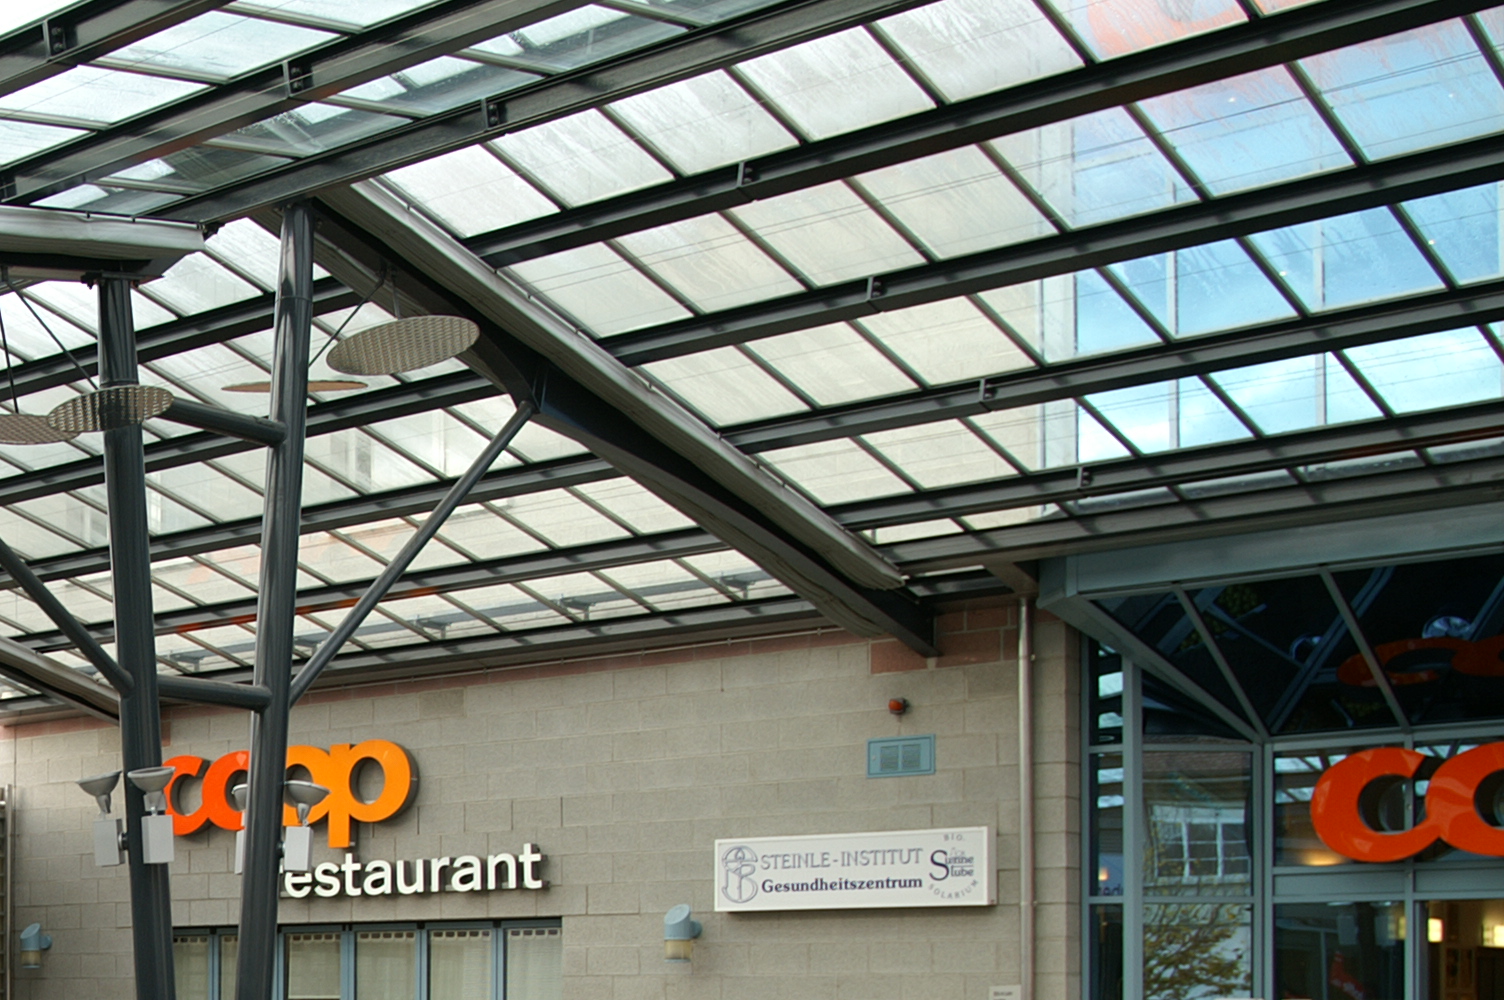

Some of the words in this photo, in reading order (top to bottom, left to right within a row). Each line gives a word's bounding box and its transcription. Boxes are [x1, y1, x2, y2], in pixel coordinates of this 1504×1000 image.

[163, 738, 413, 848] coop
[280, 843, 544, 898] estaurant
[761, 877, 923, 893] Gesundheitszentrum
